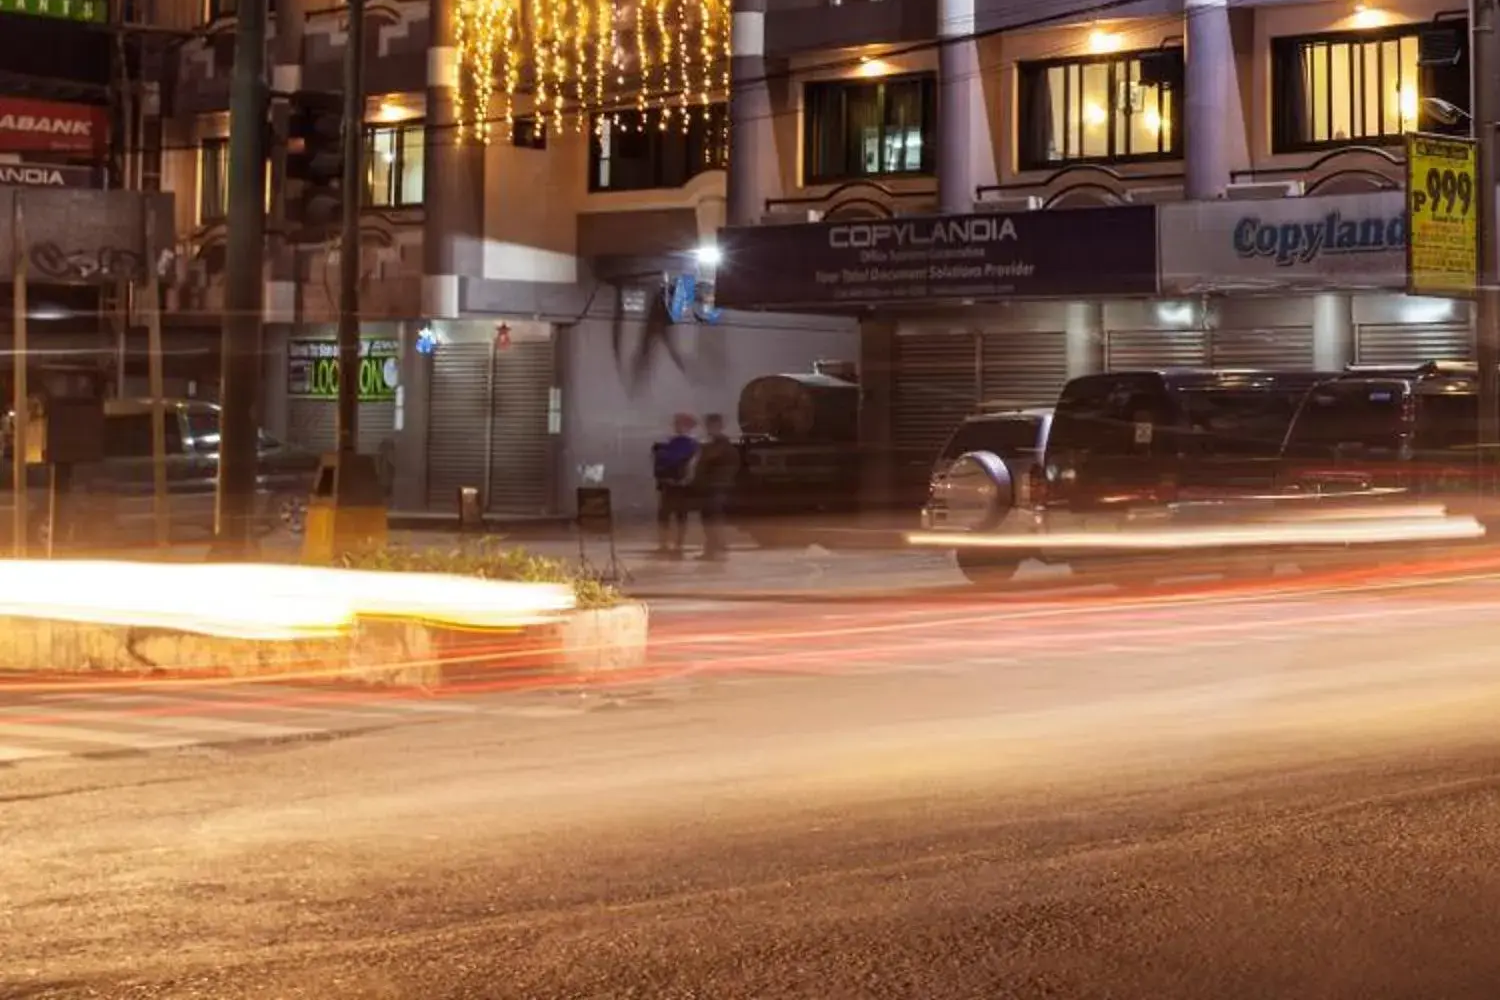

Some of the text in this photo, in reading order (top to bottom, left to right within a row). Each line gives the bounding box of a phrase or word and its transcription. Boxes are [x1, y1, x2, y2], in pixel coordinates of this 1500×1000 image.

[829, 217, 1018, 248] COPYLANDIA
[984, 261, 1036, 277] Provider
[311, 359, 383, 394] LOCON
